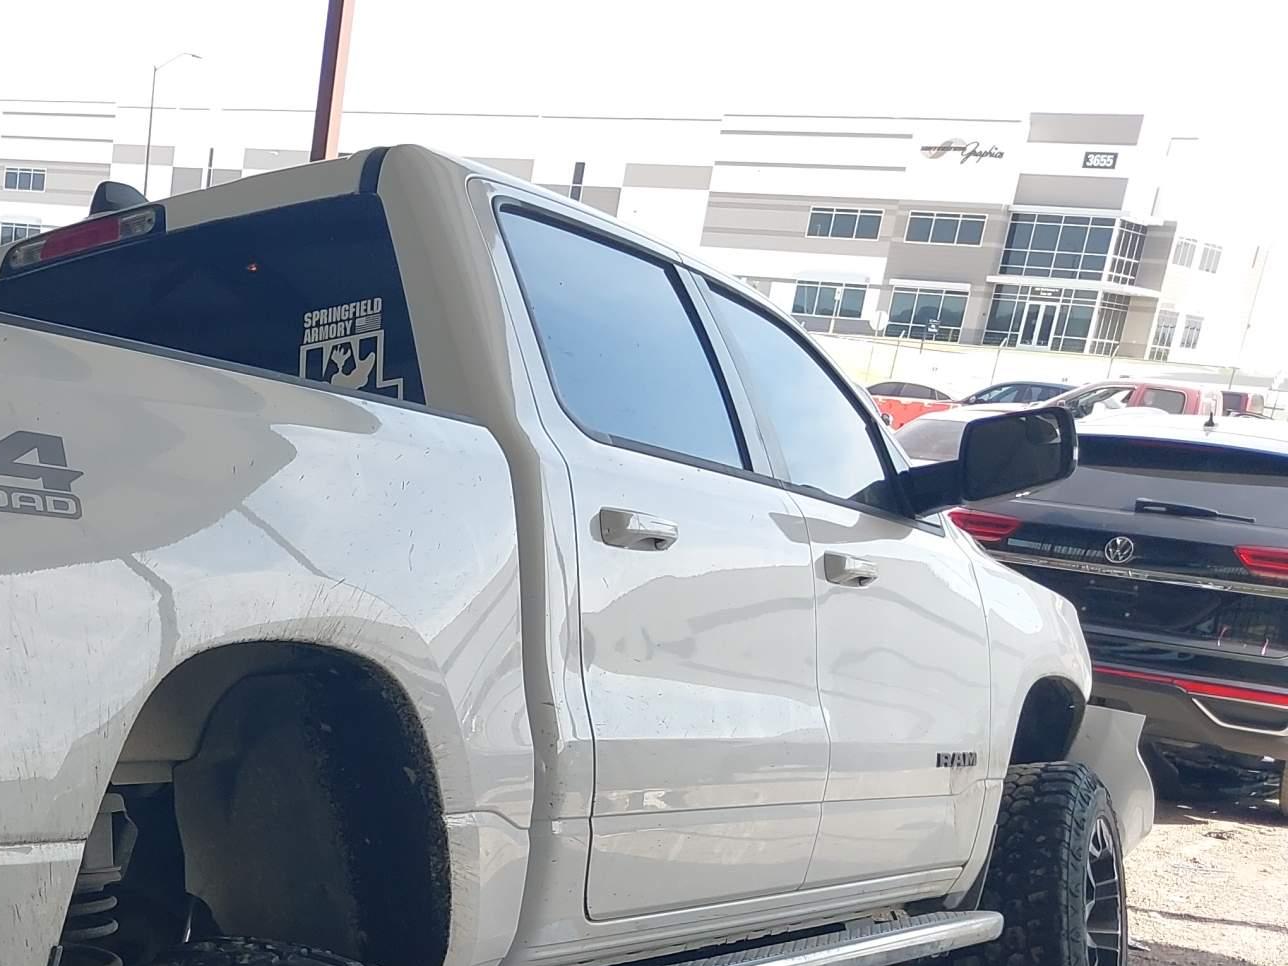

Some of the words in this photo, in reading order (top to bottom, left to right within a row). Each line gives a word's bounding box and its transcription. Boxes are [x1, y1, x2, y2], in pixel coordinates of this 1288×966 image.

[960, 141, 1004, 165] Graphics
[1086, 154, 1114, 167] 3655
[303, 297, 382, 329] SPRINGFIELD
[303, 320, 352, 344] ARMORY
[936, 752, 978, 768] RAM
